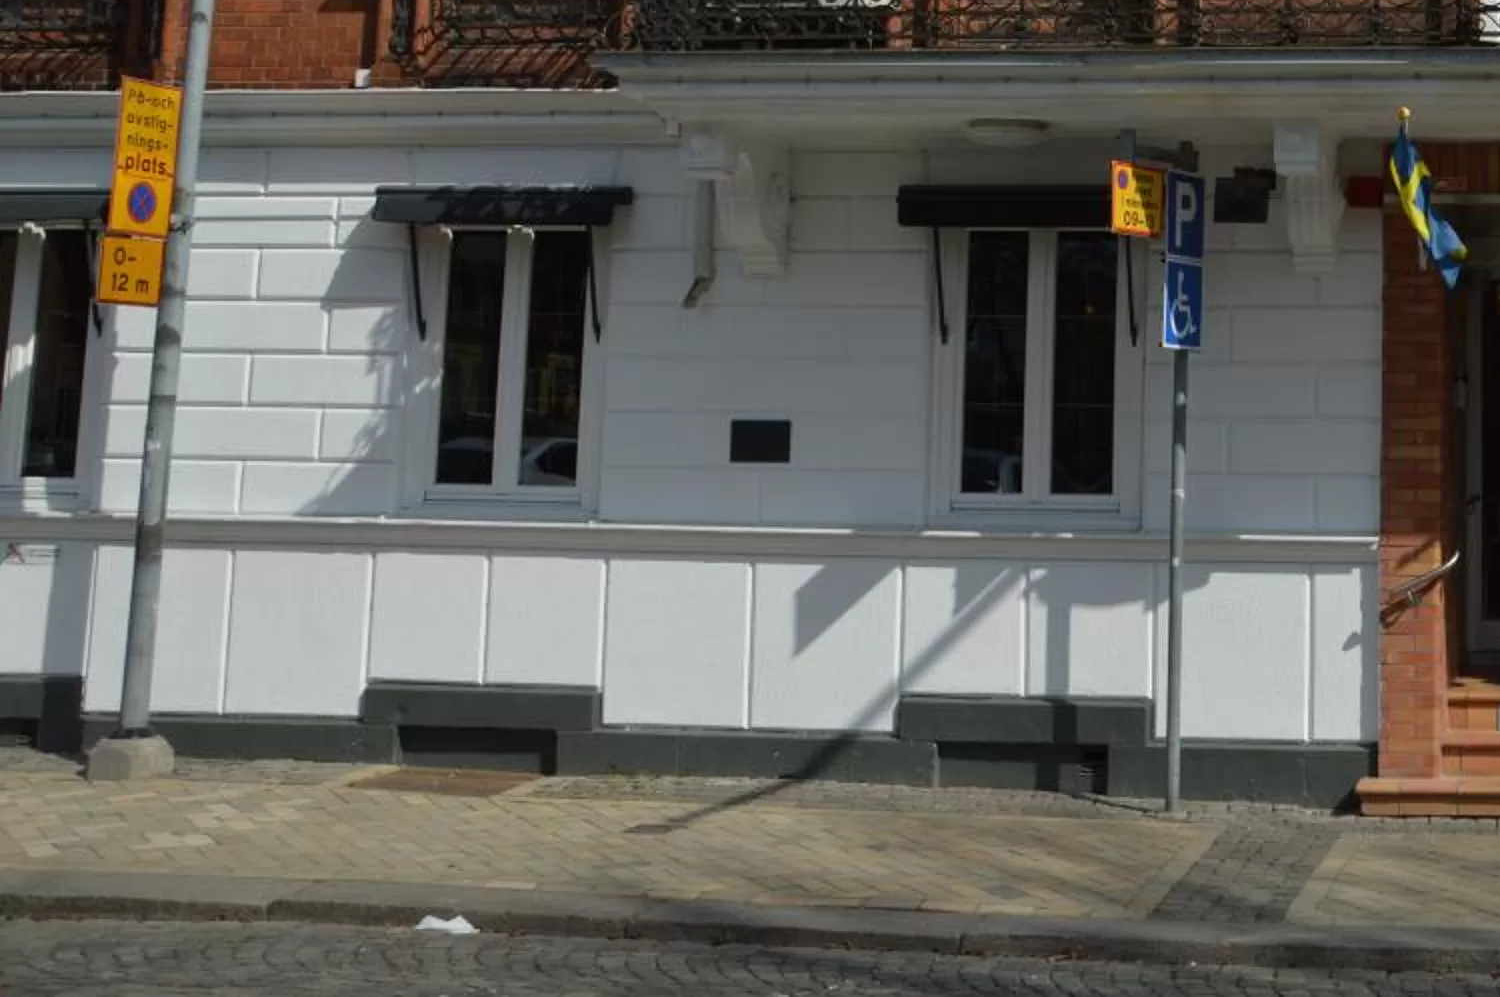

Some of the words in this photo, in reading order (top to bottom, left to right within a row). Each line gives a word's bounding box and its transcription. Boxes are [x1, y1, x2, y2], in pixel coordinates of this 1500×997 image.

[125, 152, 167, 175] plats
[1175, 182, 1196, 248] P
[111, 274, 129, 292] 12
[135, 278, 150, 293] m
